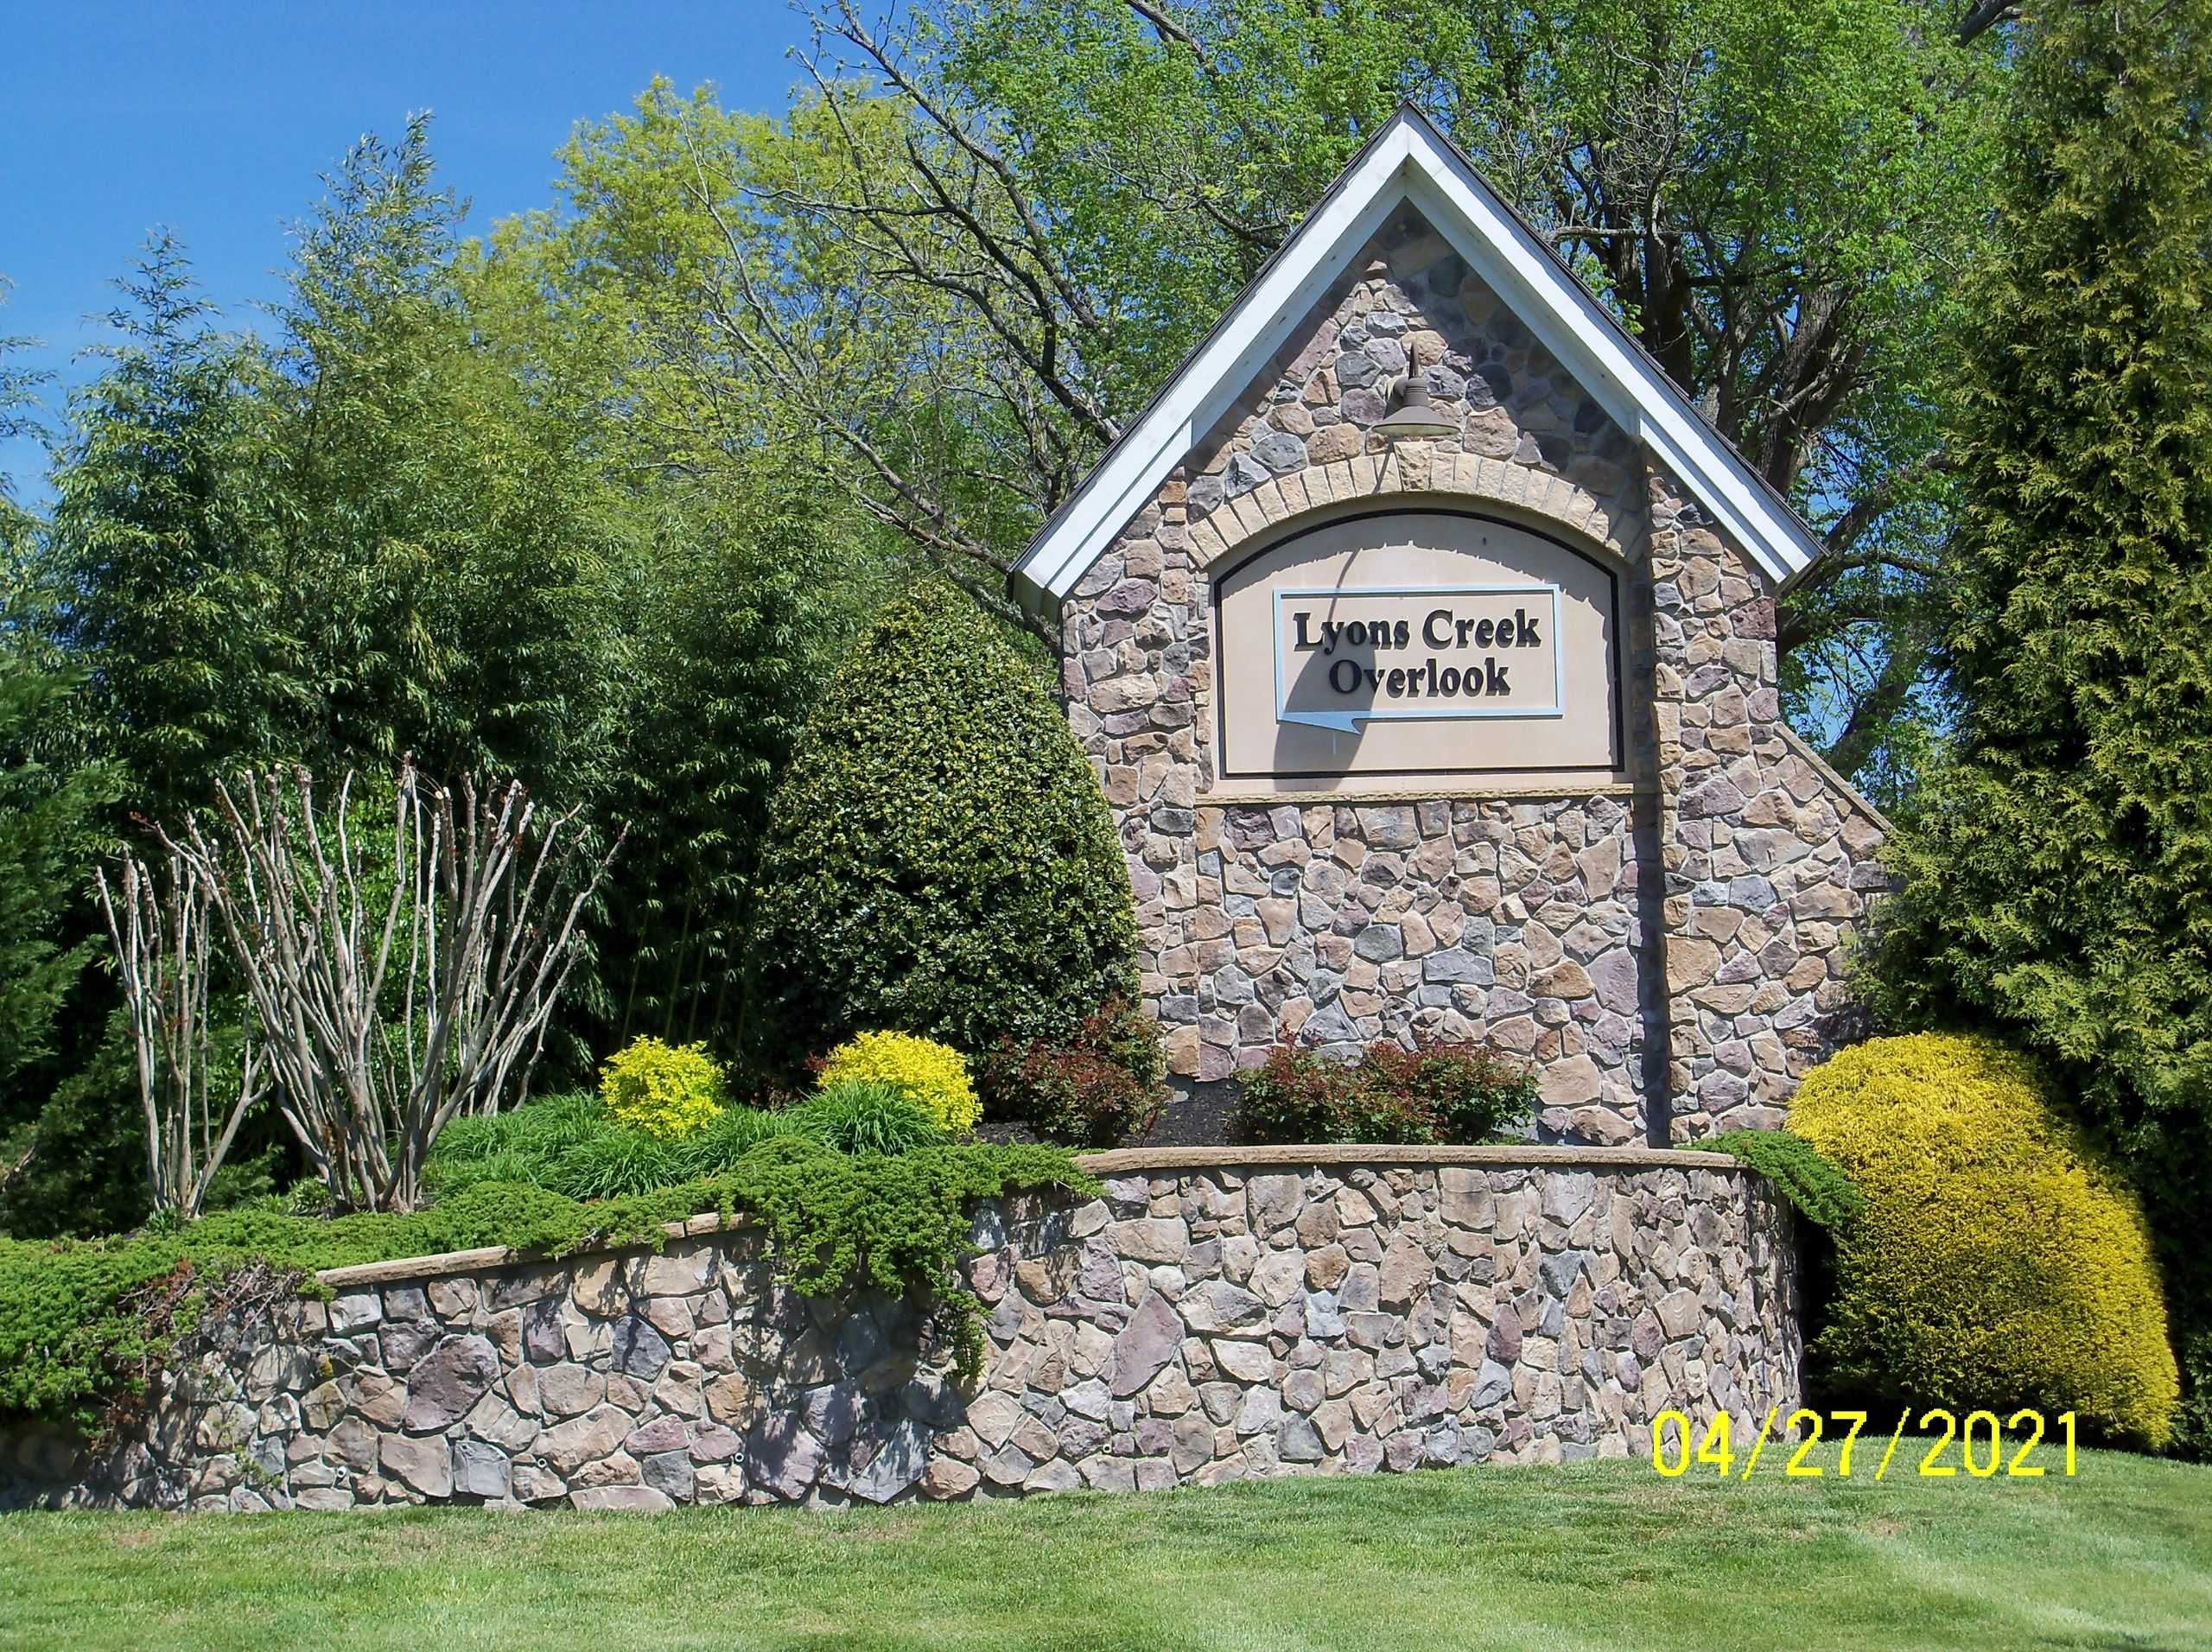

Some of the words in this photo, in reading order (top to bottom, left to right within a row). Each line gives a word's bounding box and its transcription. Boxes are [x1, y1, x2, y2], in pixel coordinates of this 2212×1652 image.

[1293, 613, 1411, 655] Lyons
[1422, 608, 1542, 650] Creek
[1329, 658, 1511, 698] Overlook
